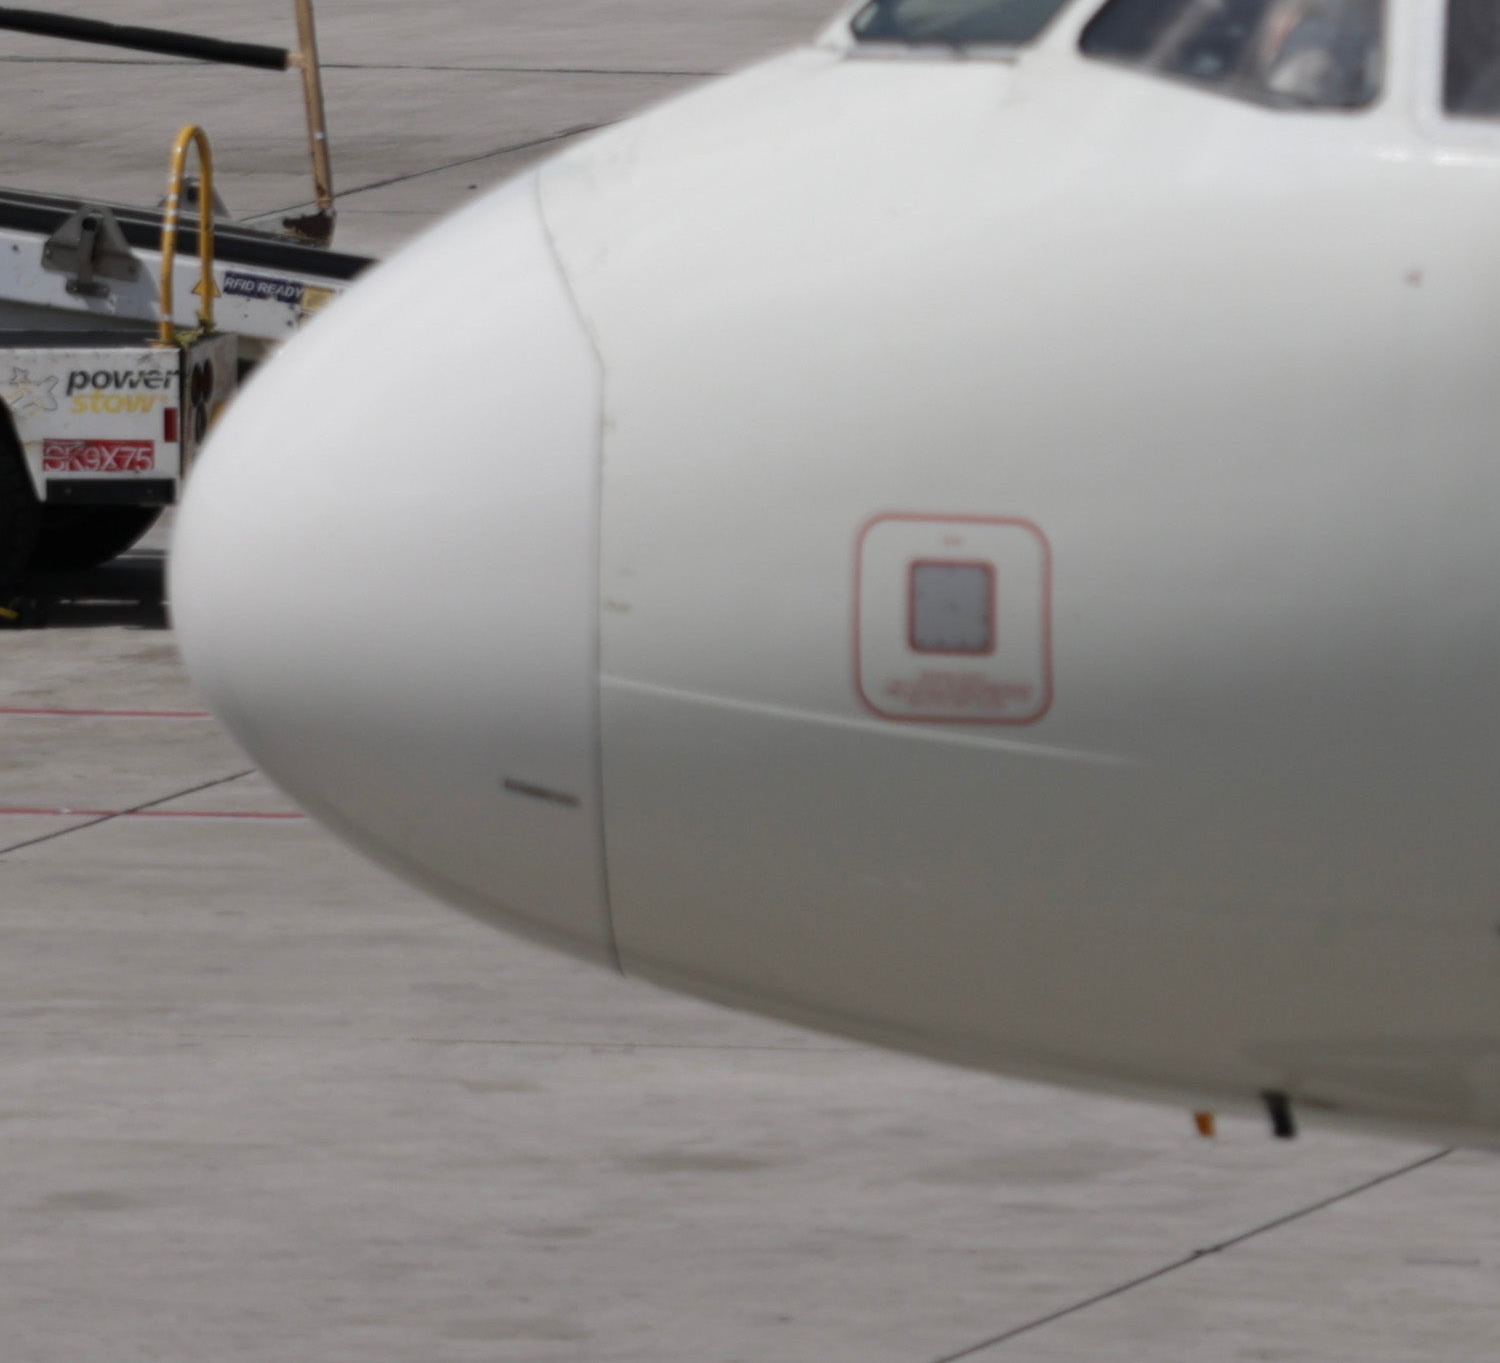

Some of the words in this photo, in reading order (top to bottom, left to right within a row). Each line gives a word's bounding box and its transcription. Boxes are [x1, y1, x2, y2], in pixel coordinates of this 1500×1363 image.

[224, 276, 255, 293] RFID
[256, 280, 304, 299] READY
[66, 367, 181, 396] power
[71, 391, 155, 414] stow
